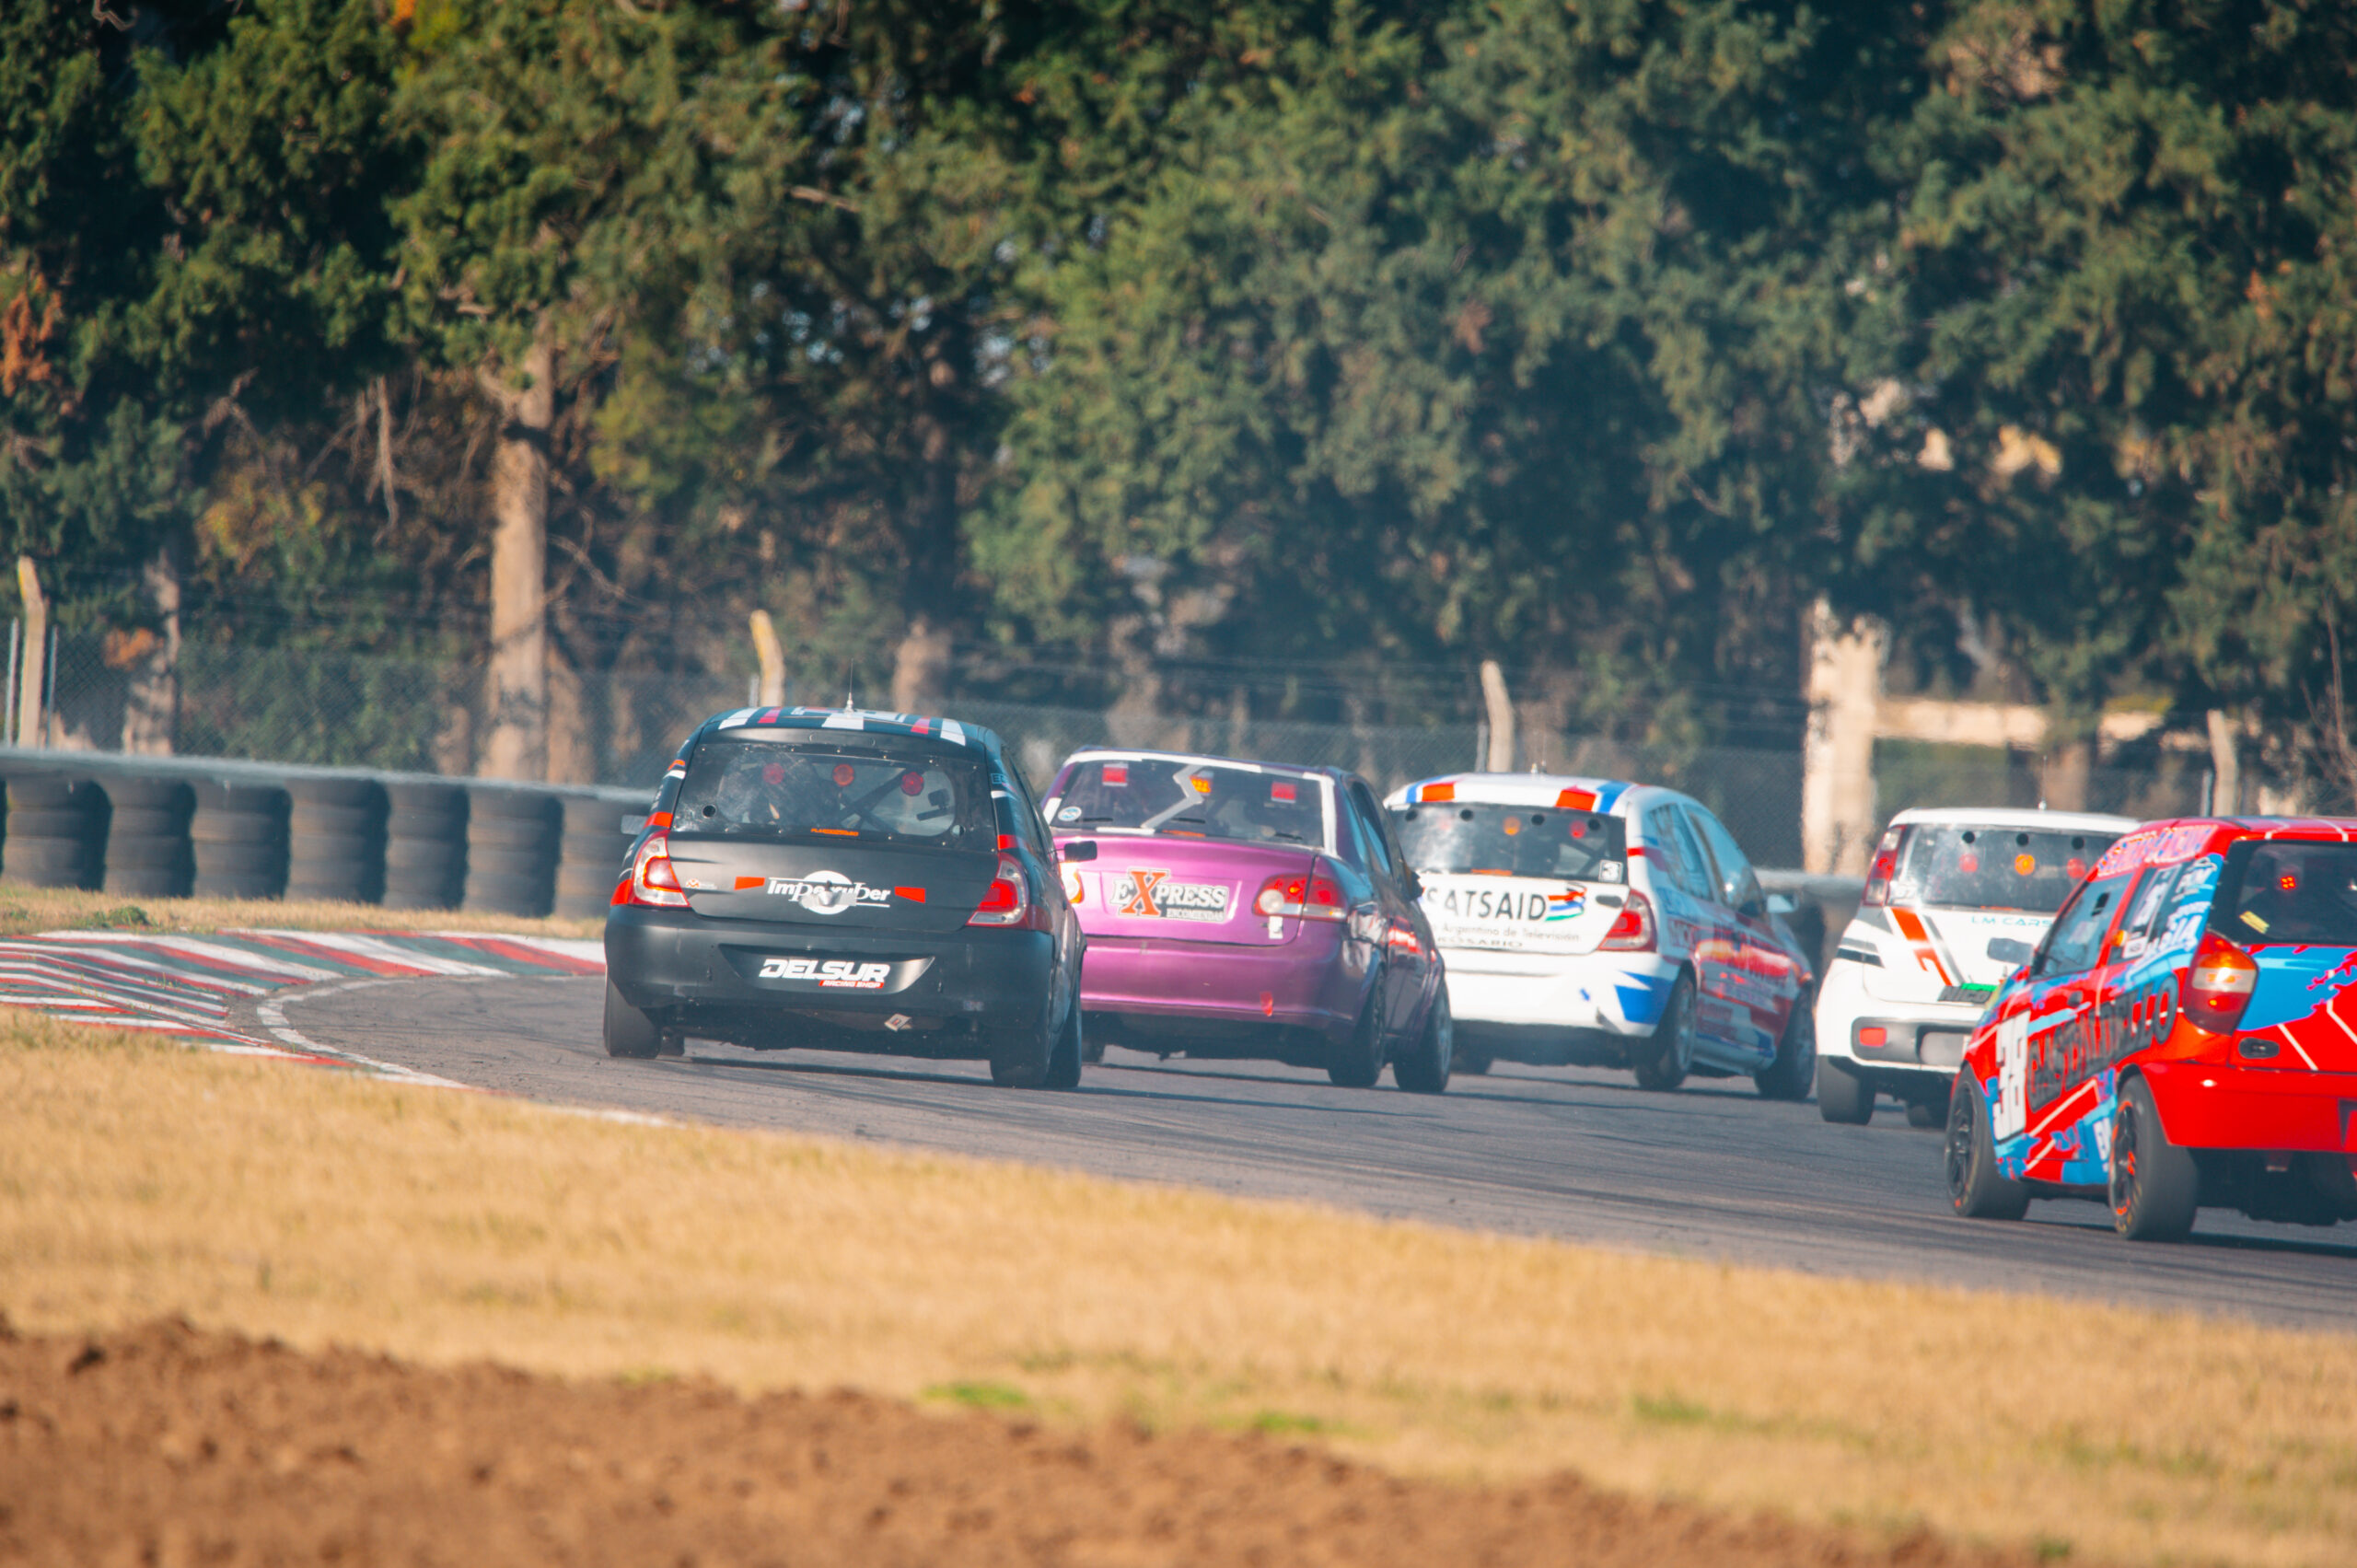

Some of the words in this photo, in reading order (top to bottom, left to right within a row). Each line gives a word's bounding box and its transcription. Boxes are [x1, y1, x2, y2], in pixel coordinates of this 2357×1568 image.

[1110, 870, 1225, 915] EXPRESS
[1426, 887, 1547, 922] SATSAID
[1971, 915, 1996, 924] LM
[759, 958, 890, 982] DELSUR
